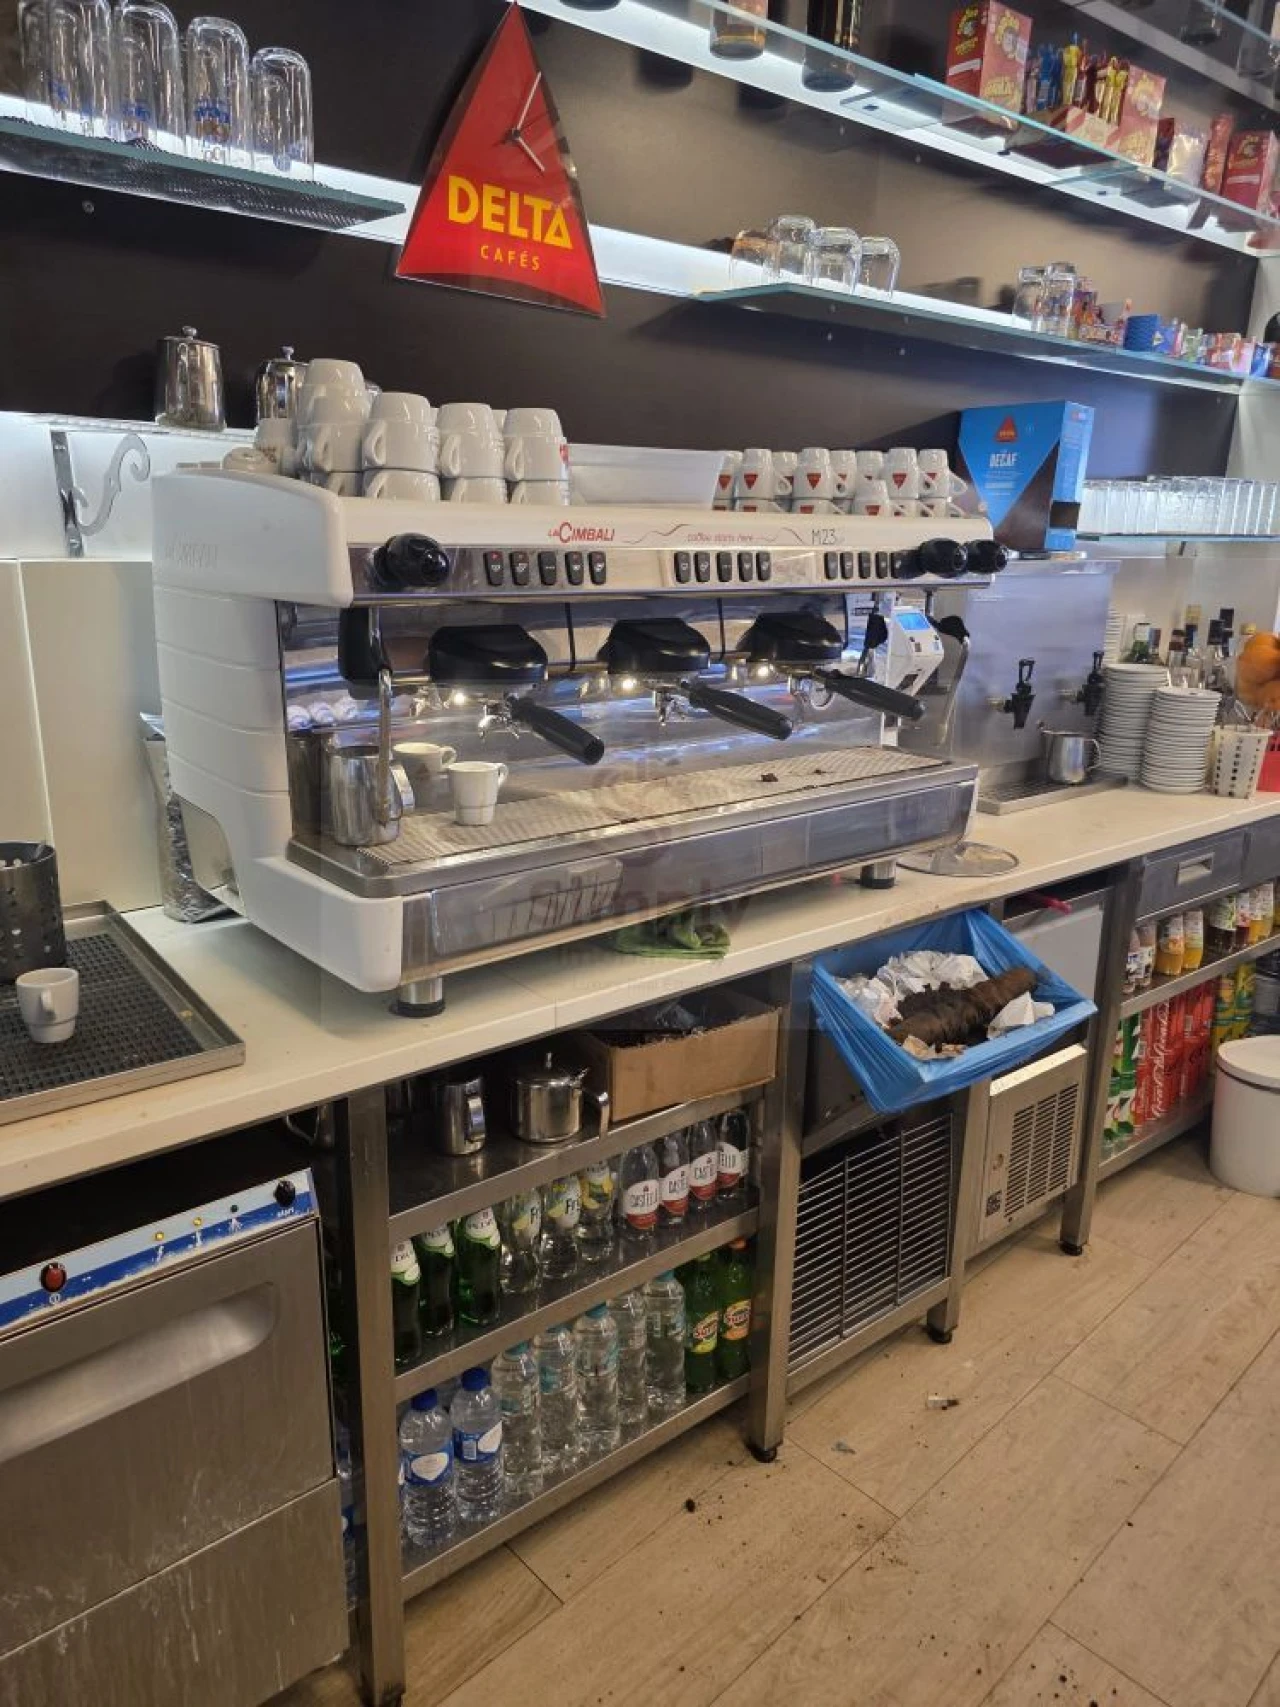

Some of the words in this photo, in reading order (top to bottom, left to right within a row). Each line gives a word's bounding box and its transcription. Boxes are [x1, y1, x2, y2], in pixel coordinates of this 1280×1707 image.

[448, 175, 573, 250] DELTA
[480, 245, 540, 271] CAFÉS
[559, 522, 615, 543] CIMBALI
